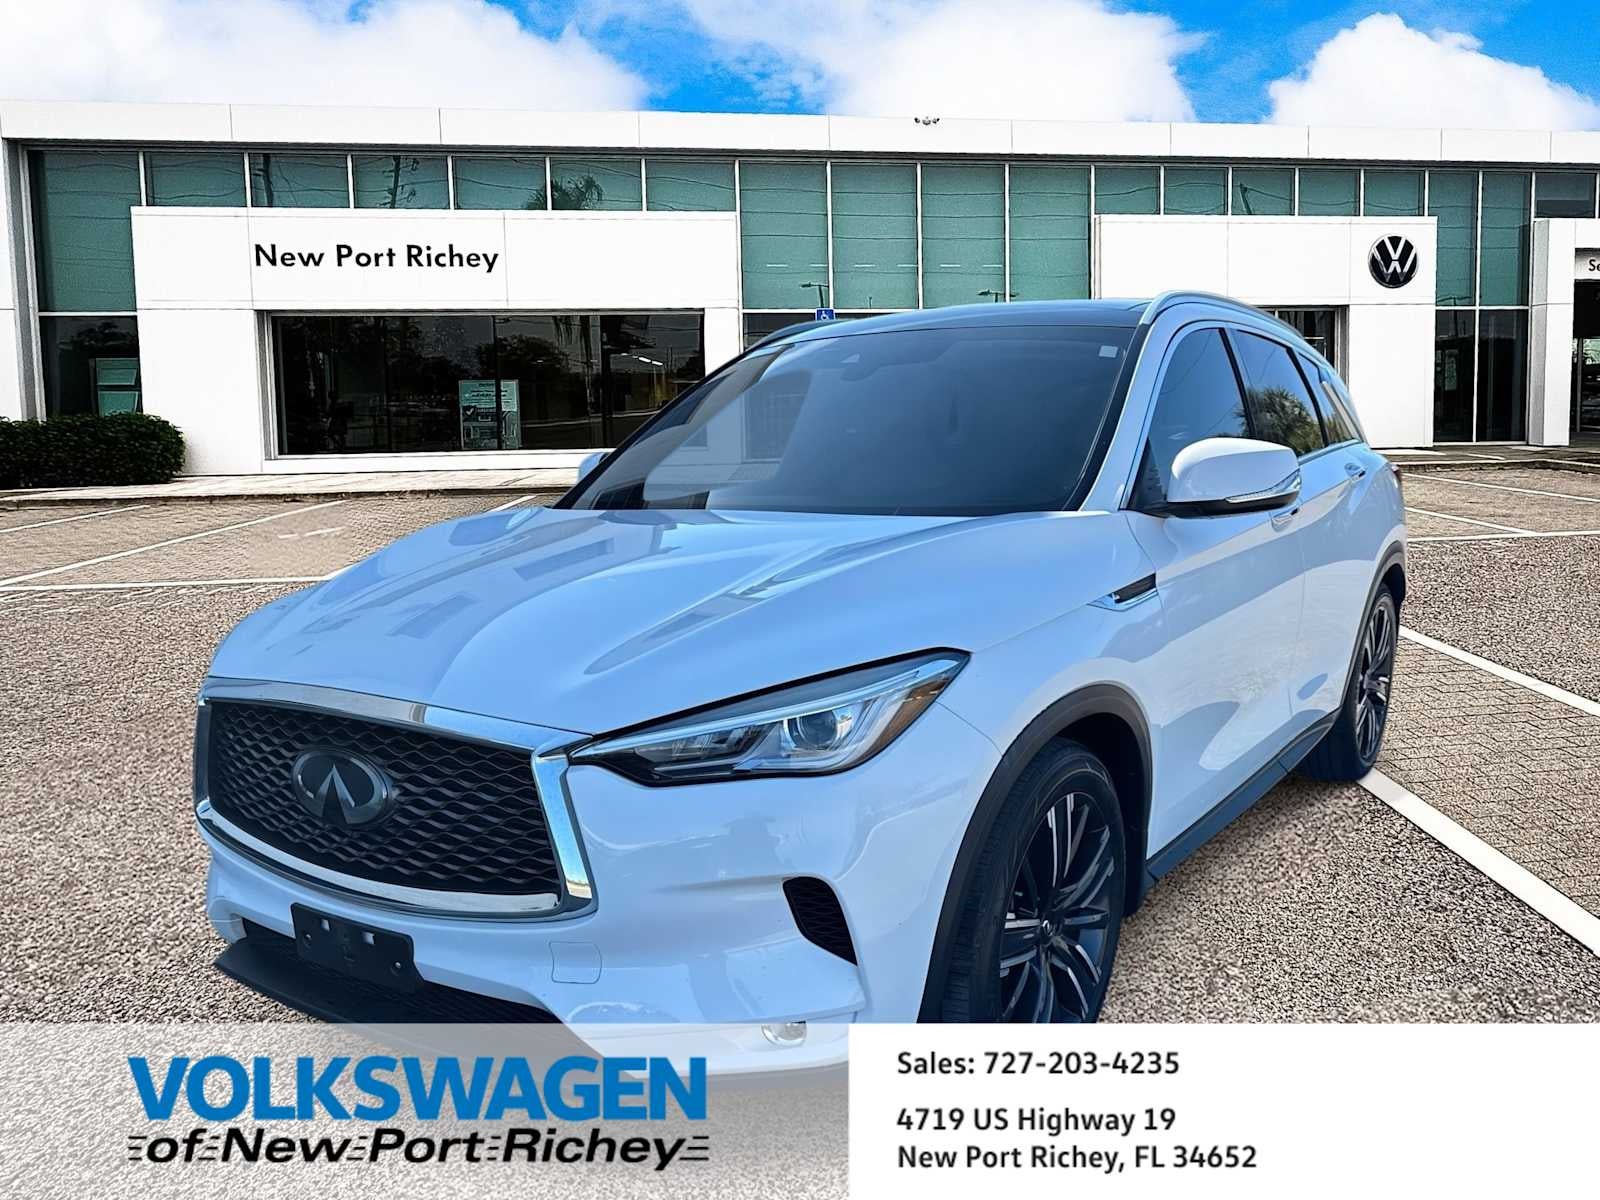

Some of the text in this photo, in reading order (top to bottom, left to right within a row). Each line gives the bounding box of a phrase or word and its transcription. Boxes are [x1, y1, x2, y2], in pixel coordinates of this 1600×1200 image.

[254, 243, 499, 273] New Port Richey
